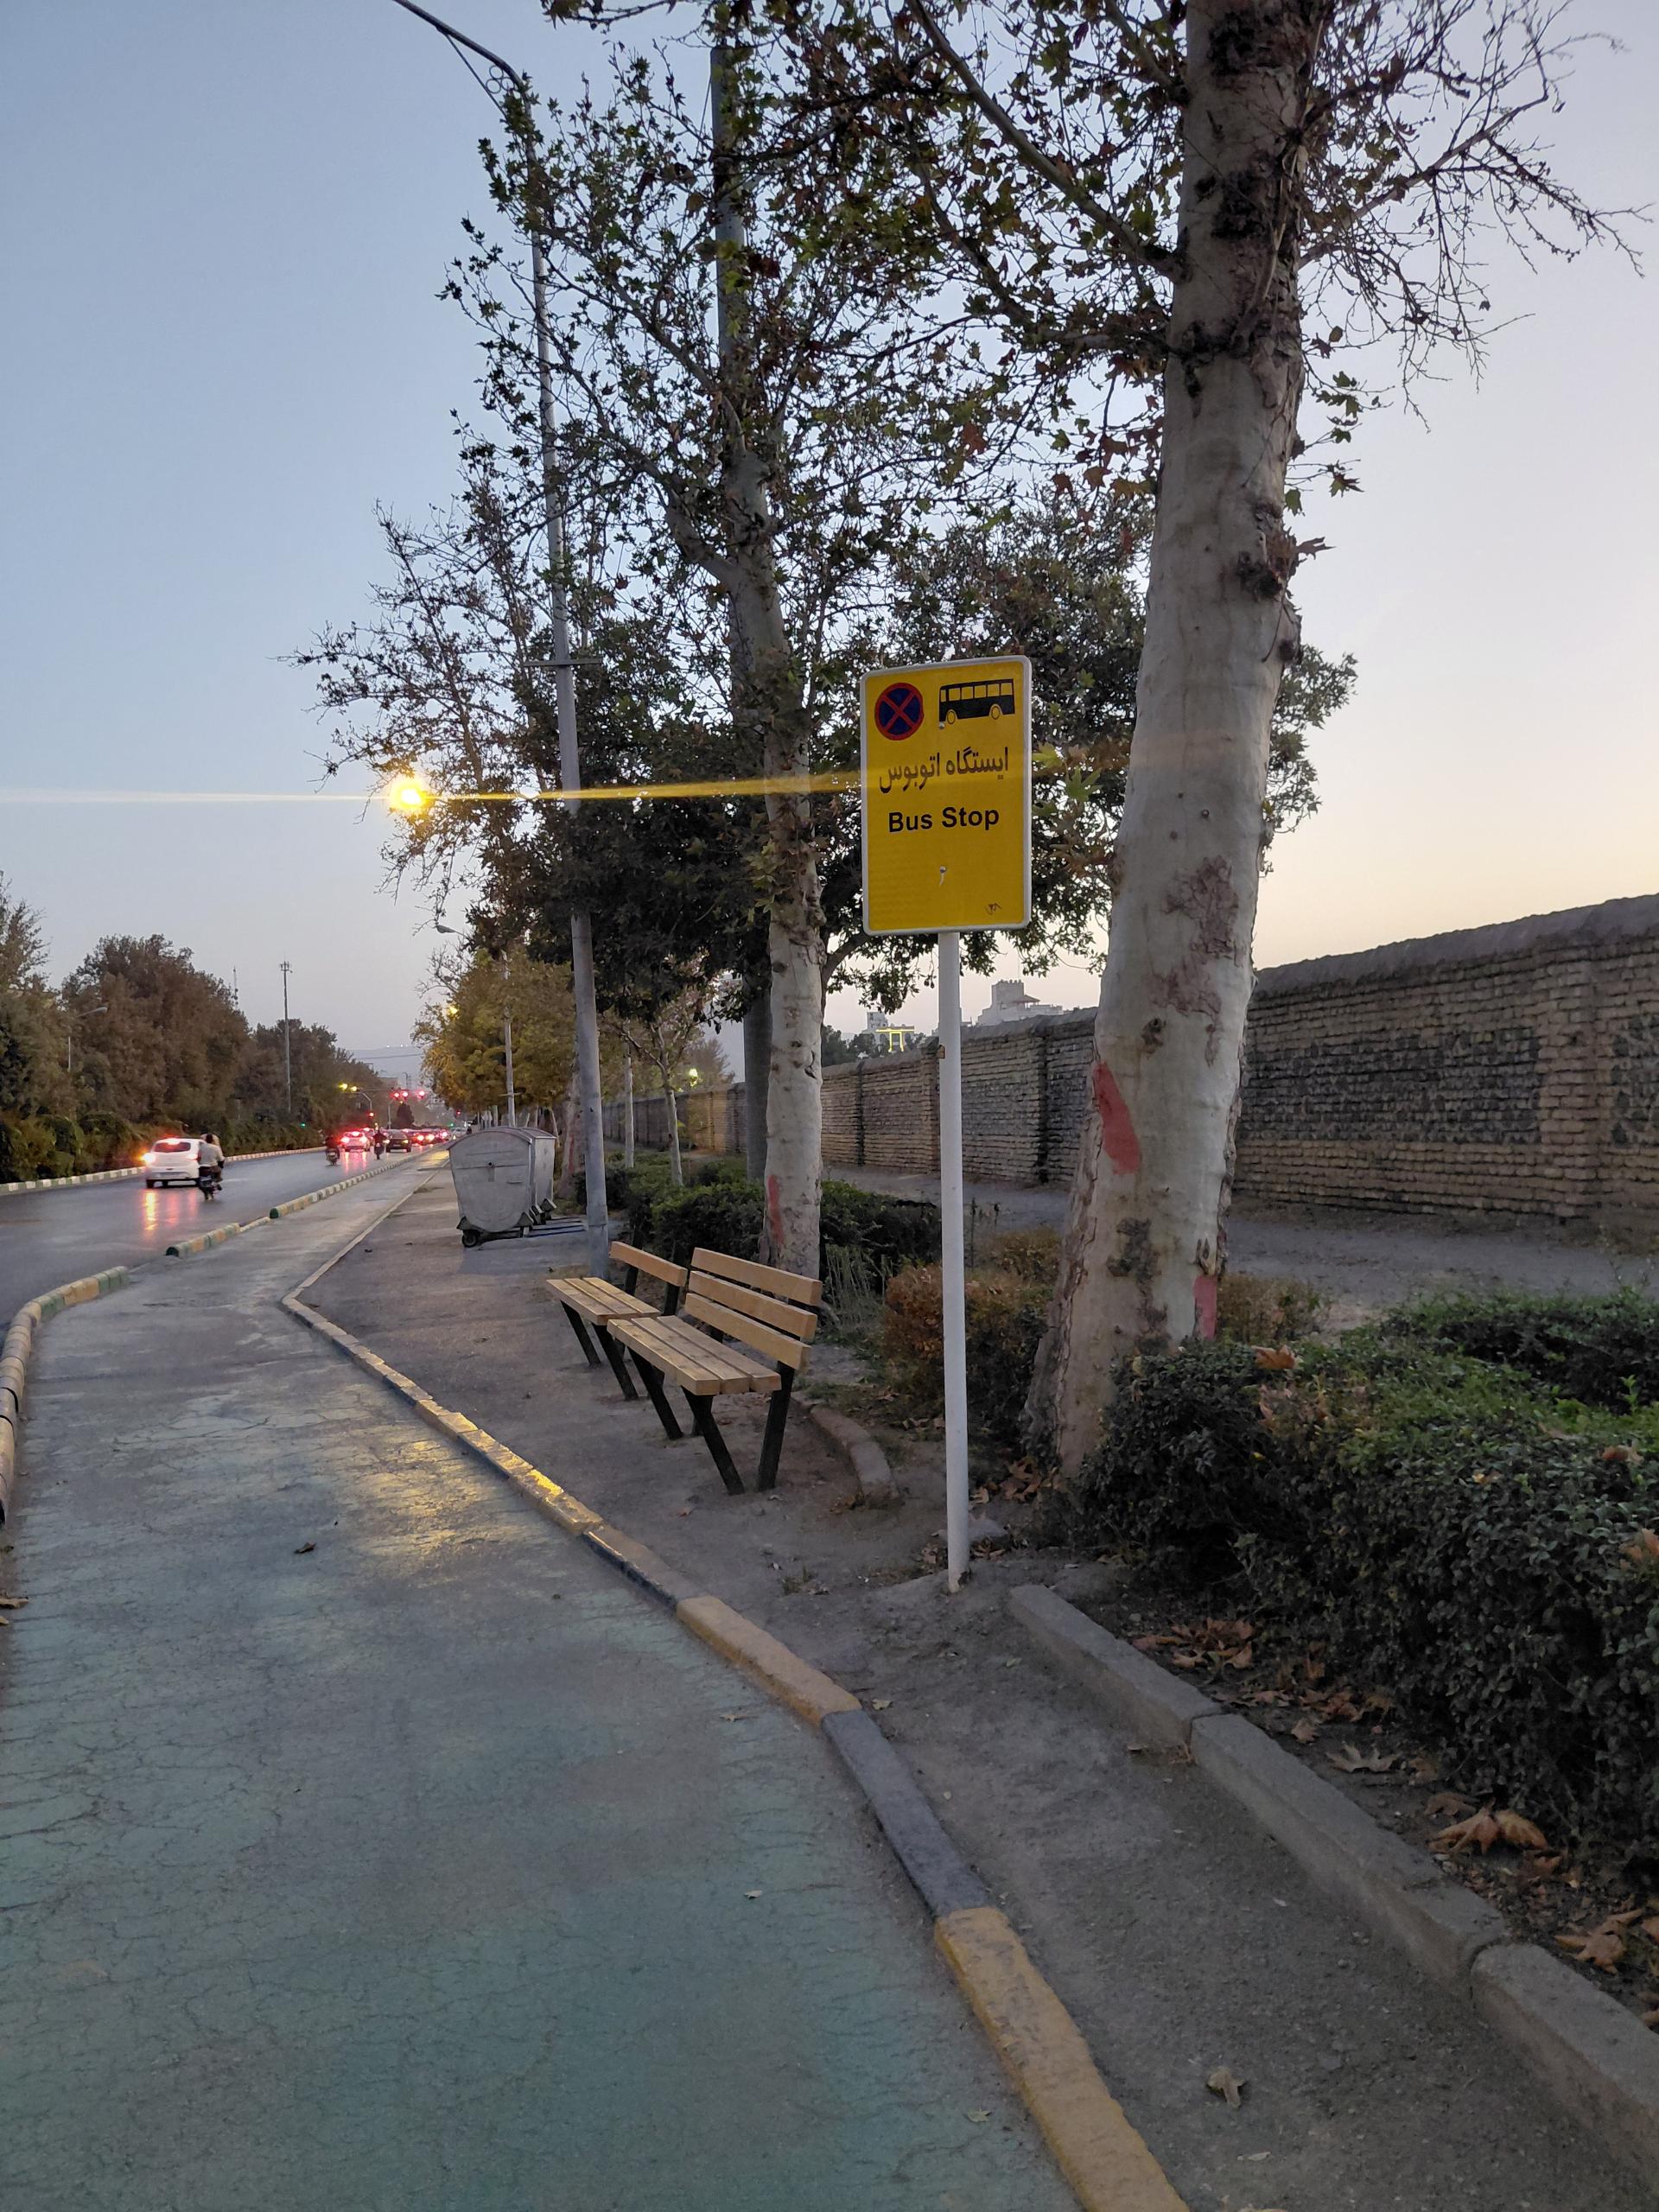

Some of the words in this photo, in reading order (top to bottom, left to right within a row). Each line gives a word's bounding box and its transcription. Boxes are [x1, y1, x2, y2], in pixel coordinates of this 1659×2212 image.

[879, 752, 940, 794] اتوبوس
[945, 746, 1008, 779] ایستگاه
[888, 811, 933, 833] Bus
[941, 806, 1000, 831] Stop
